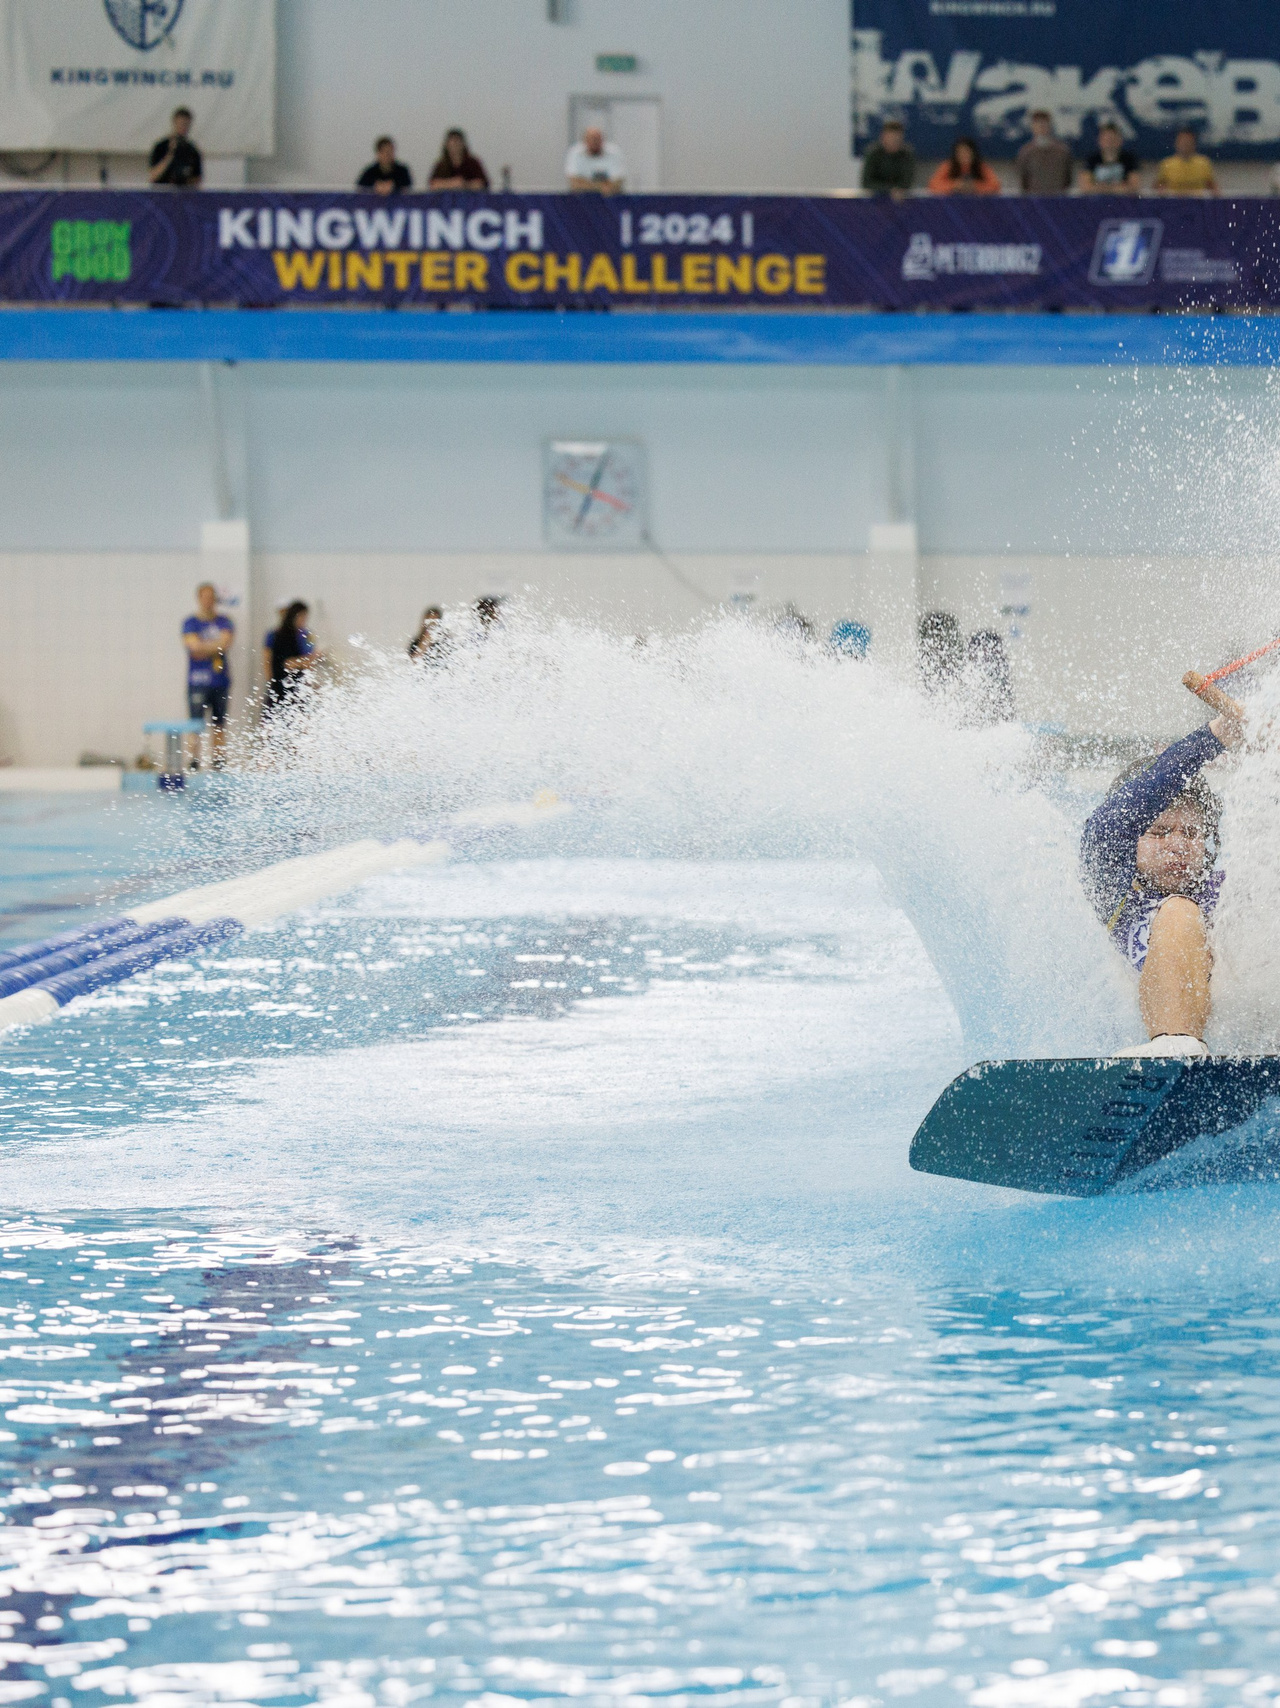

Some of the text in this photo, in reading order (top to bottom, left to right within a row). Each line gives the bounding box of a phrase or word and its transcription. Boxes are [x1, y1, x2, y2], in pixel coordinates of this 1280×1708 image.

[50, 67, 235, 88] KINGWINCH.RU
[218, 208, 544, 249] KINGWINCH
[272, 250, 826, 294] WINTER CHALLENGE
